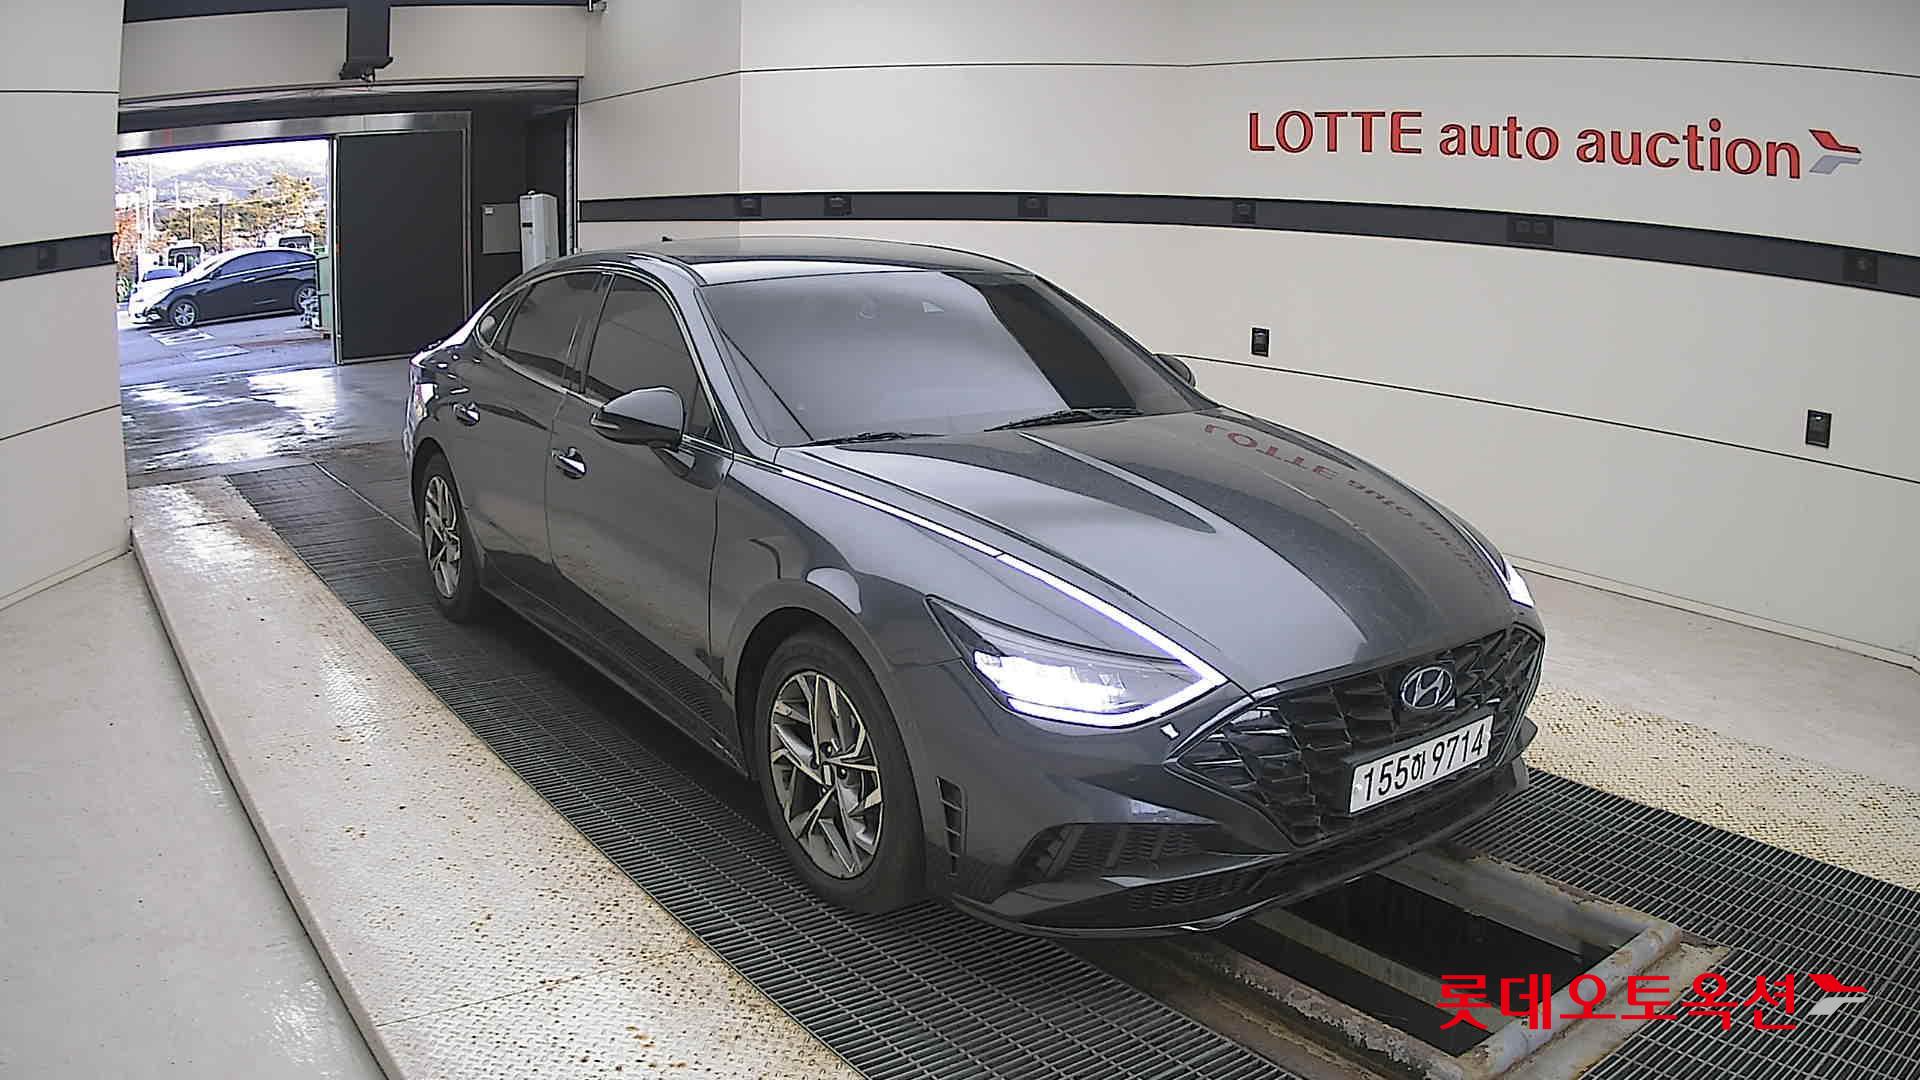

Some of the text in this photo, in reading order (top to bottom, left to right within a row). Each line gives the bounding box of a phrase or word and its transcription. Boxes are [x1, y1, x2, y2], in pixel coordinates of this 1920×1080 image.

[1249, 111, 1801, 179] LOTTE auto auction
[1363, 723, 1485, 801] 155하 9714
